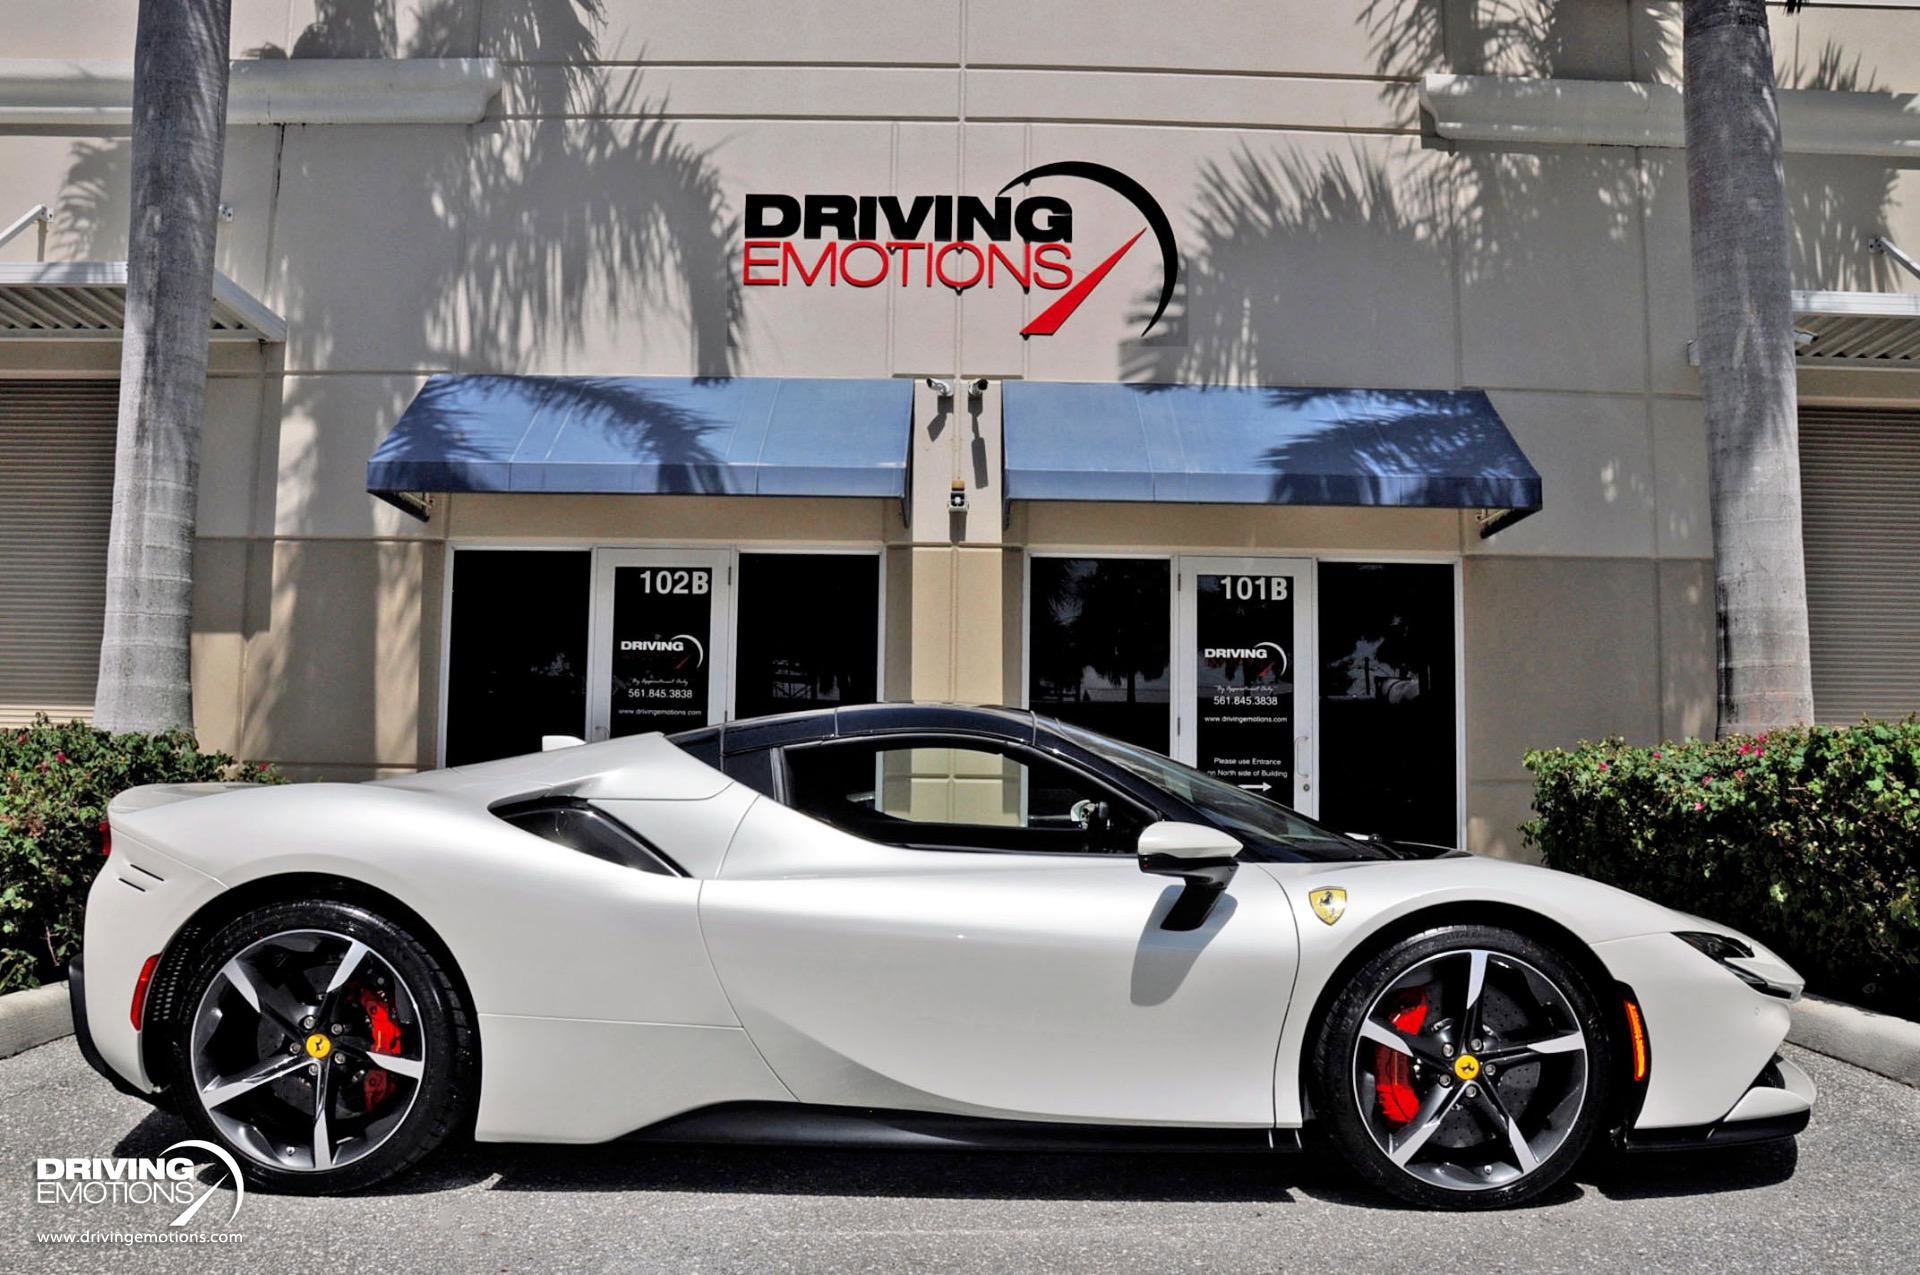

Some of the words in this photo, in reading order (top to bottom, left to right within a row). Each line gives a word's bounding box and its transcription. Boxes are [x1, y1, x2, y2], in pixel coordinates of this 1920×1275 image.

[744, 194, 1073, 243] DRIVING
[743, 241, 1073, 289] EMOTIONS
[640, 570, 709, 595] 102B
[1220, 576, 1288, 601] 101B
[621, 641, 684, 651] DRIVING
[1204, 648, 1268, 659] DRIVING
[627, 688, 693, 698] 561.845.3838
[1213, 695, 1278, 706] 561.845.3838
[1213, 757, 1237, 765] Please
[1251, 757, 1282, 765] Entrance
[1217, 769, 1237, 777] North
[1237, 769, 1252, 777] side
[1252, 769, 1260, 777] of
[1261, 770, 1288, 778] Building
